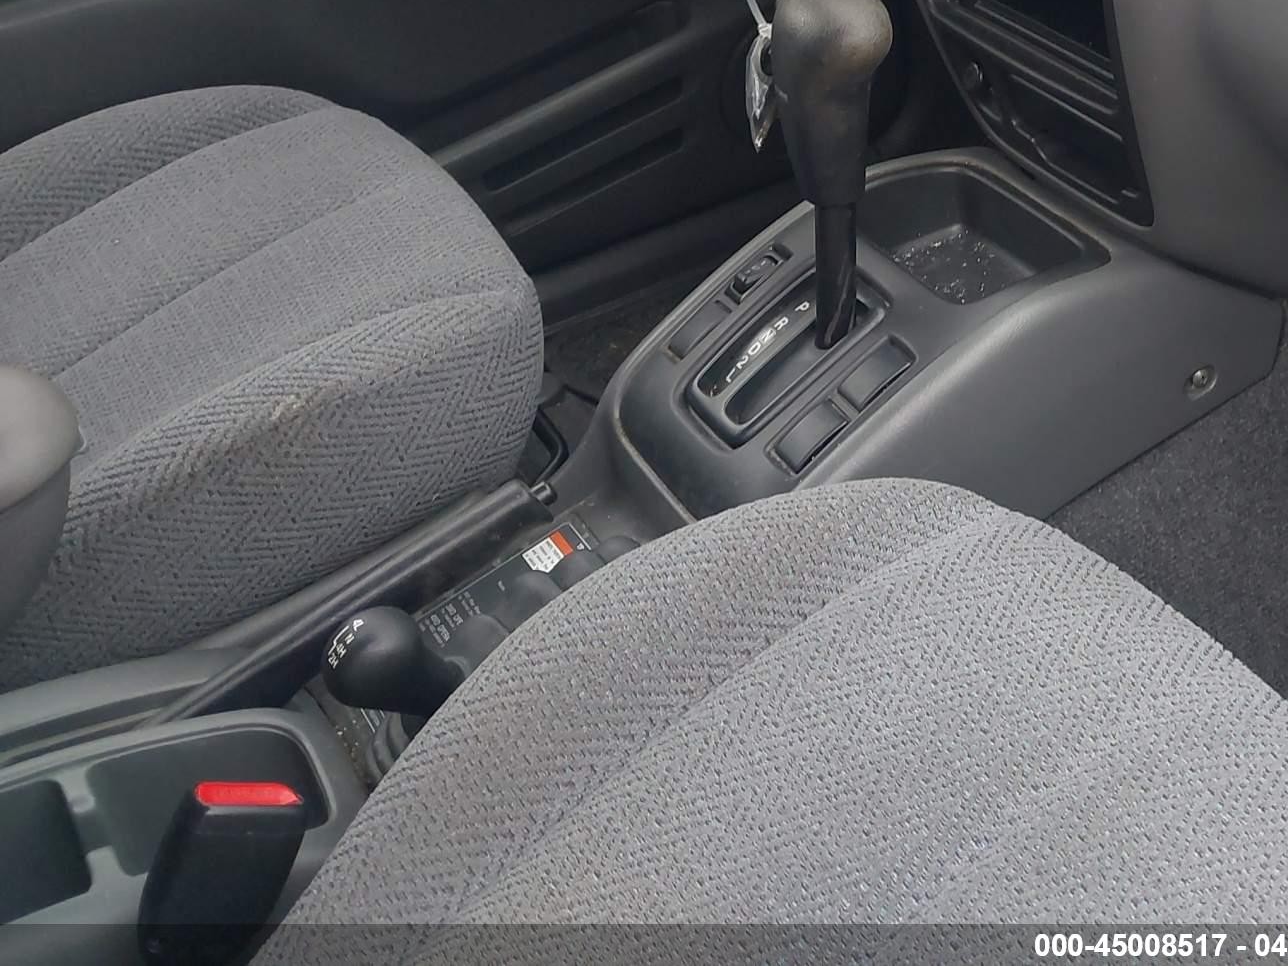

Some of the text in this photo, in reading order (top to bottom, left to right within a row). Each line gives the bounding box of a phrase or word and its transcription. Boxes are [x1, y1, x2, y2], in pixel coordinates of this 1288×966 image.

[794, 301, 810, 312] P
[773, 316, 789, 331] R
[735, 355, 749, 369] 2
